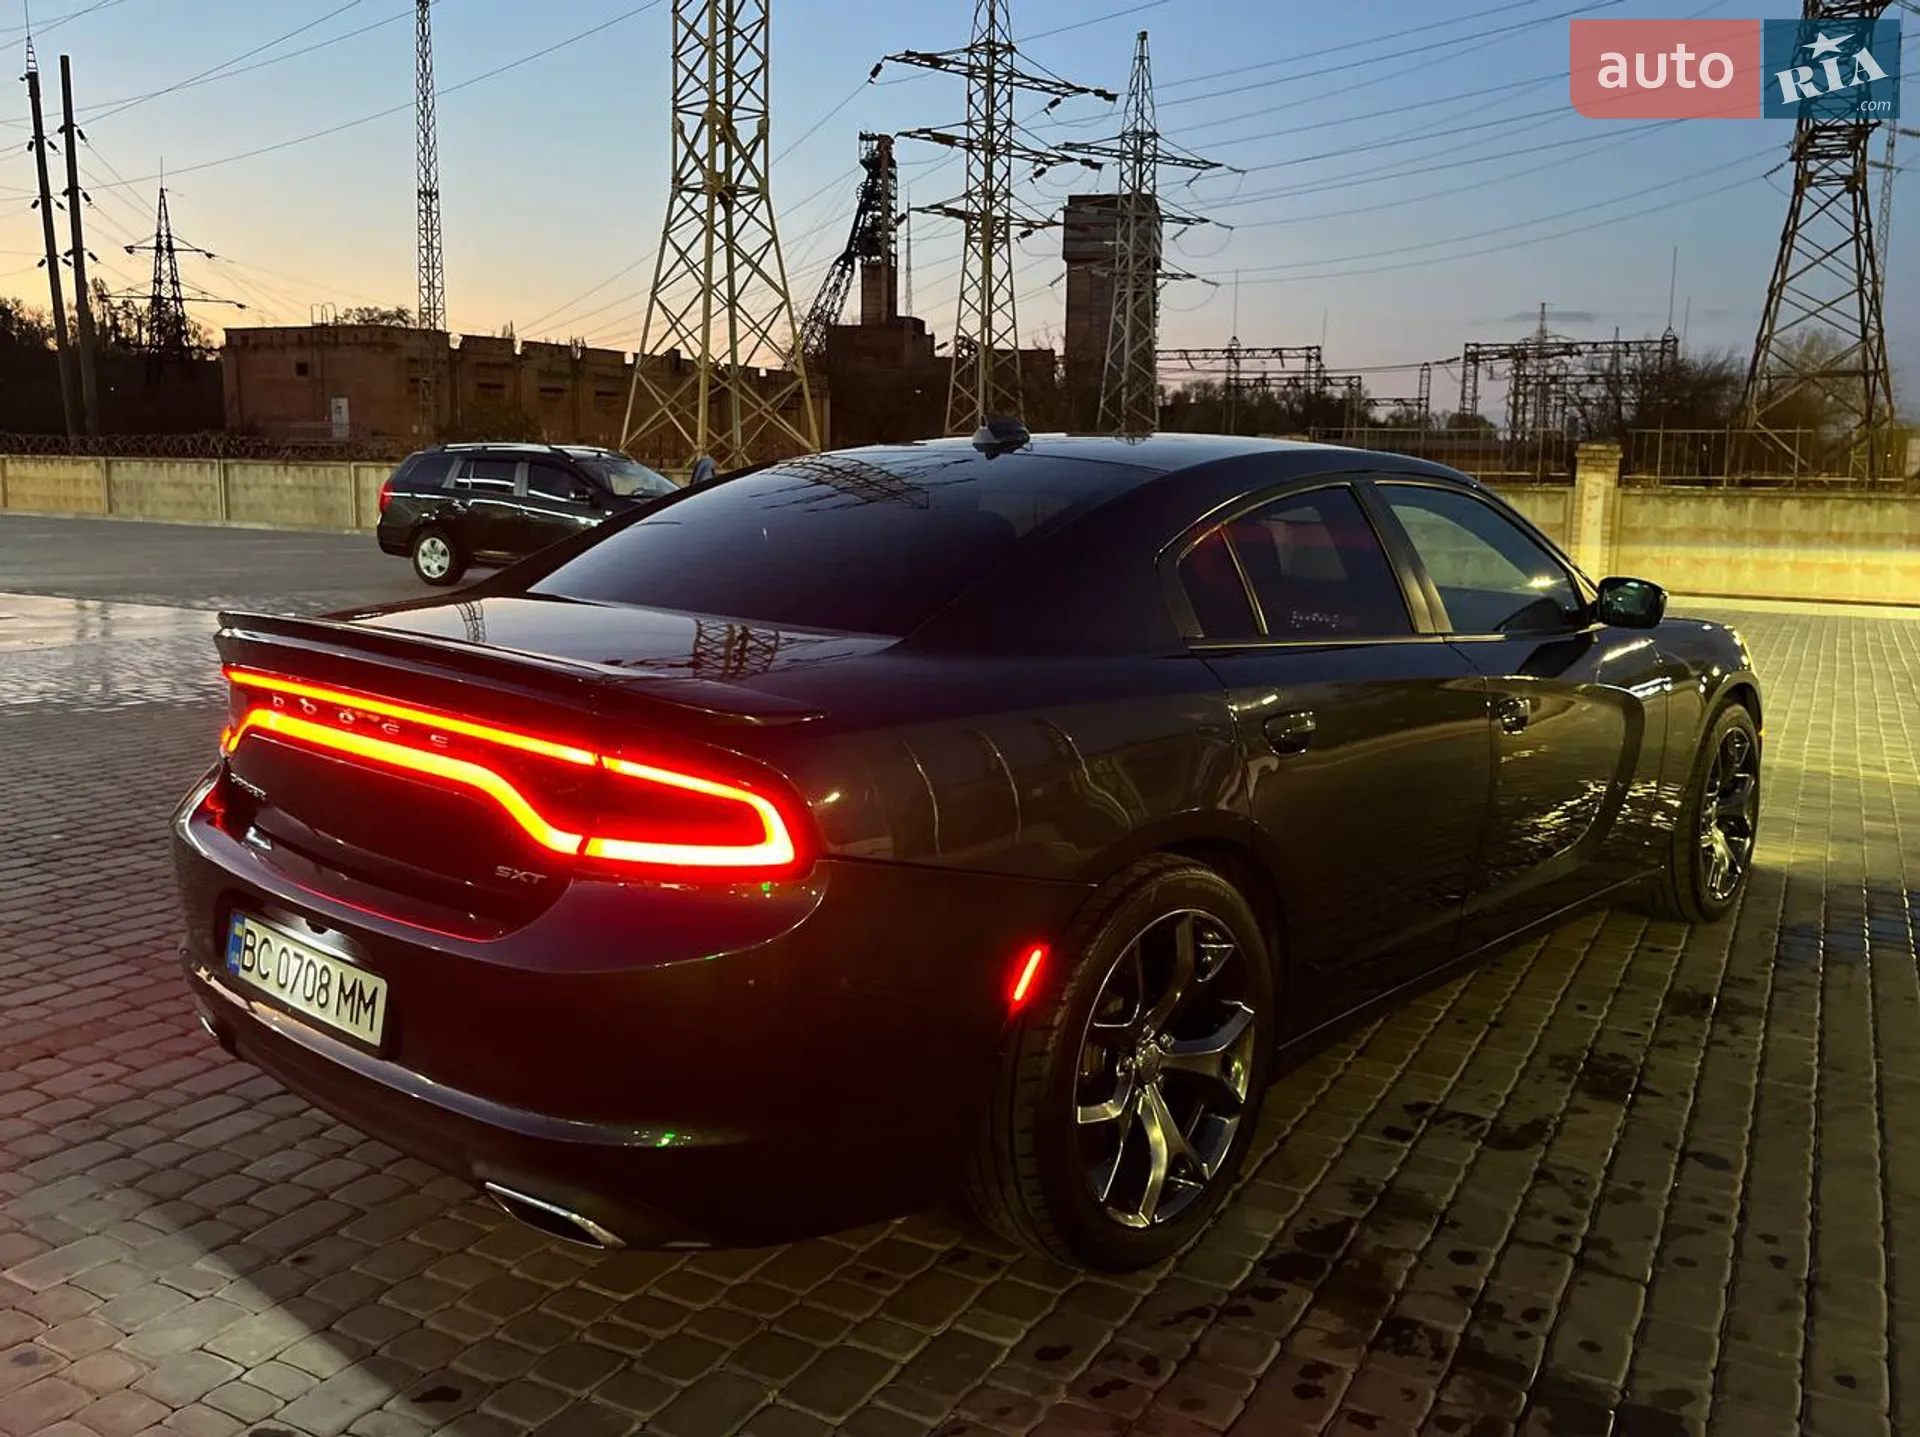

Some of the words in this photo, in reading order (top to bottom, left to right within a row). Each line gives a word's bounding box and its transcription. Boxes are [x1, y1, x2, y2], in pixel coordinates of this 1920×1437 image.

[495, 865, 548, 884] SXT
[242, 928, 273, 981] BC
[277, 947, 331, 1009] 0708
[336, 972, 378, 1032] MM
